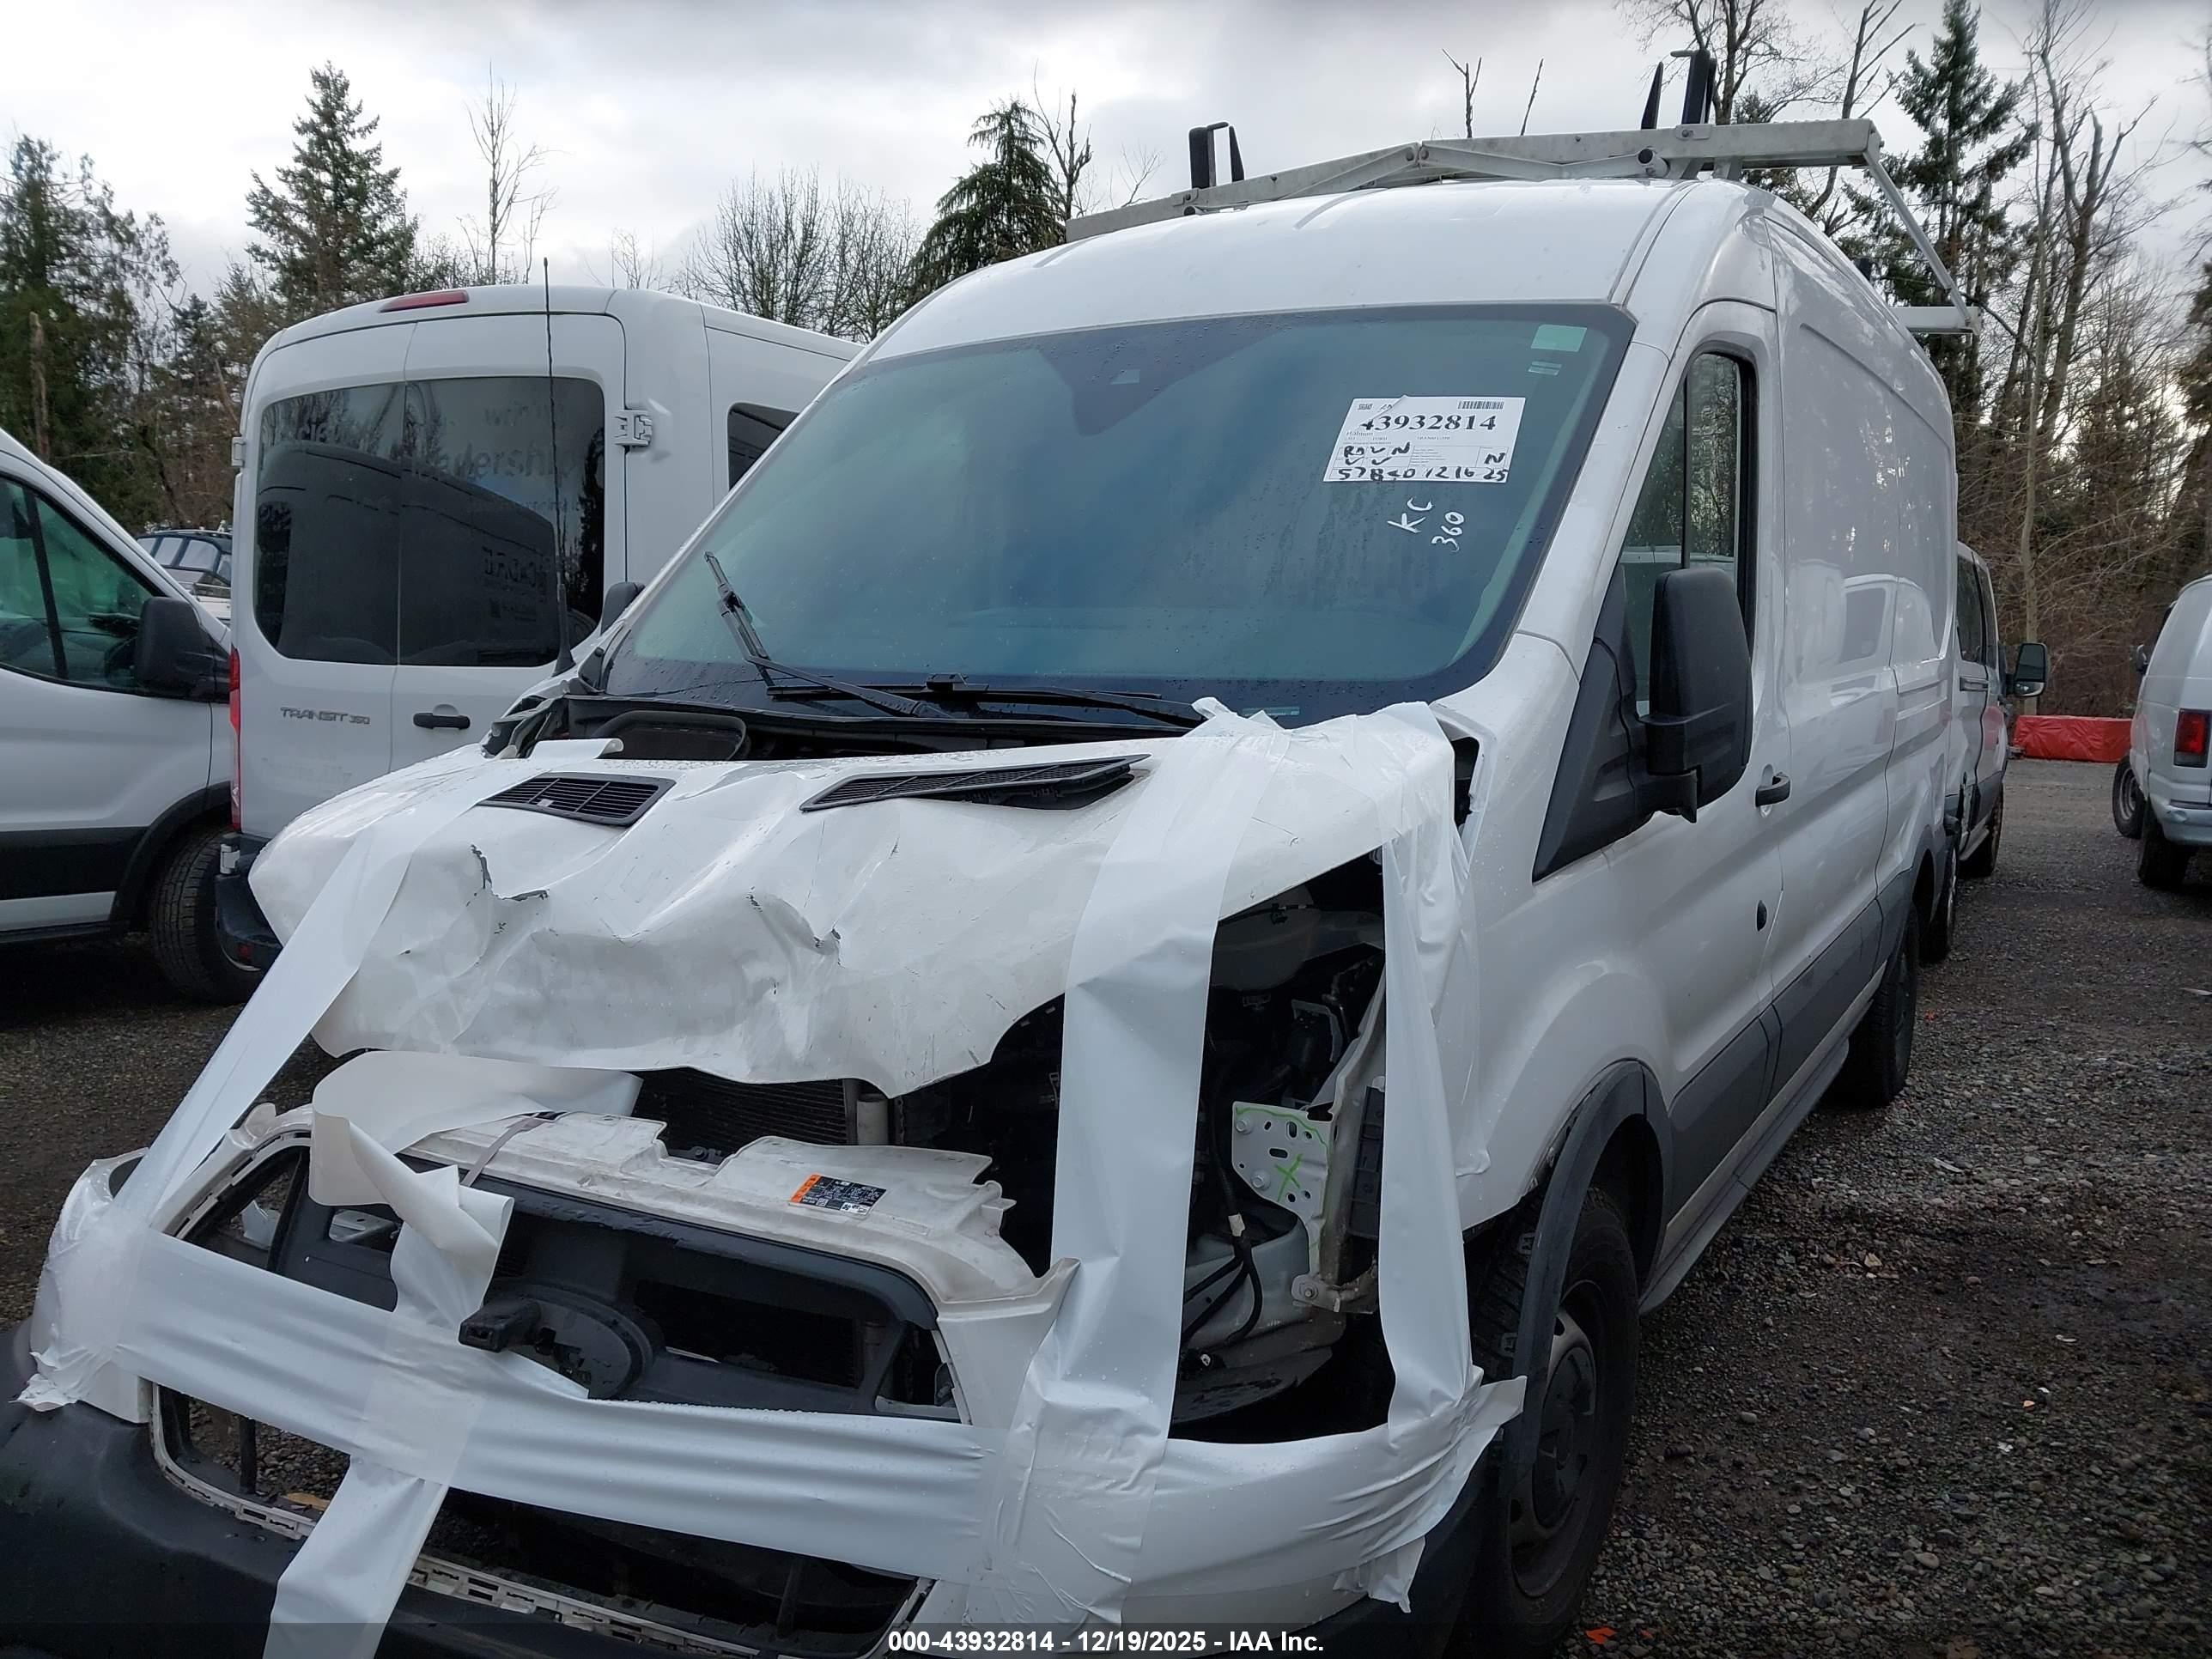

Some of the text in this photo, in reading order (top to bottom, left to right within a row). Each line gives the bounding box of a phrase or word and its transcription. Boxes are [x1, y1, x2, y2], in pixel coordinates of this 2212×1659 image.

[1359, 414, 1497, 431] 43932814
[280, 706, 371, 725] TRANSIT 350
